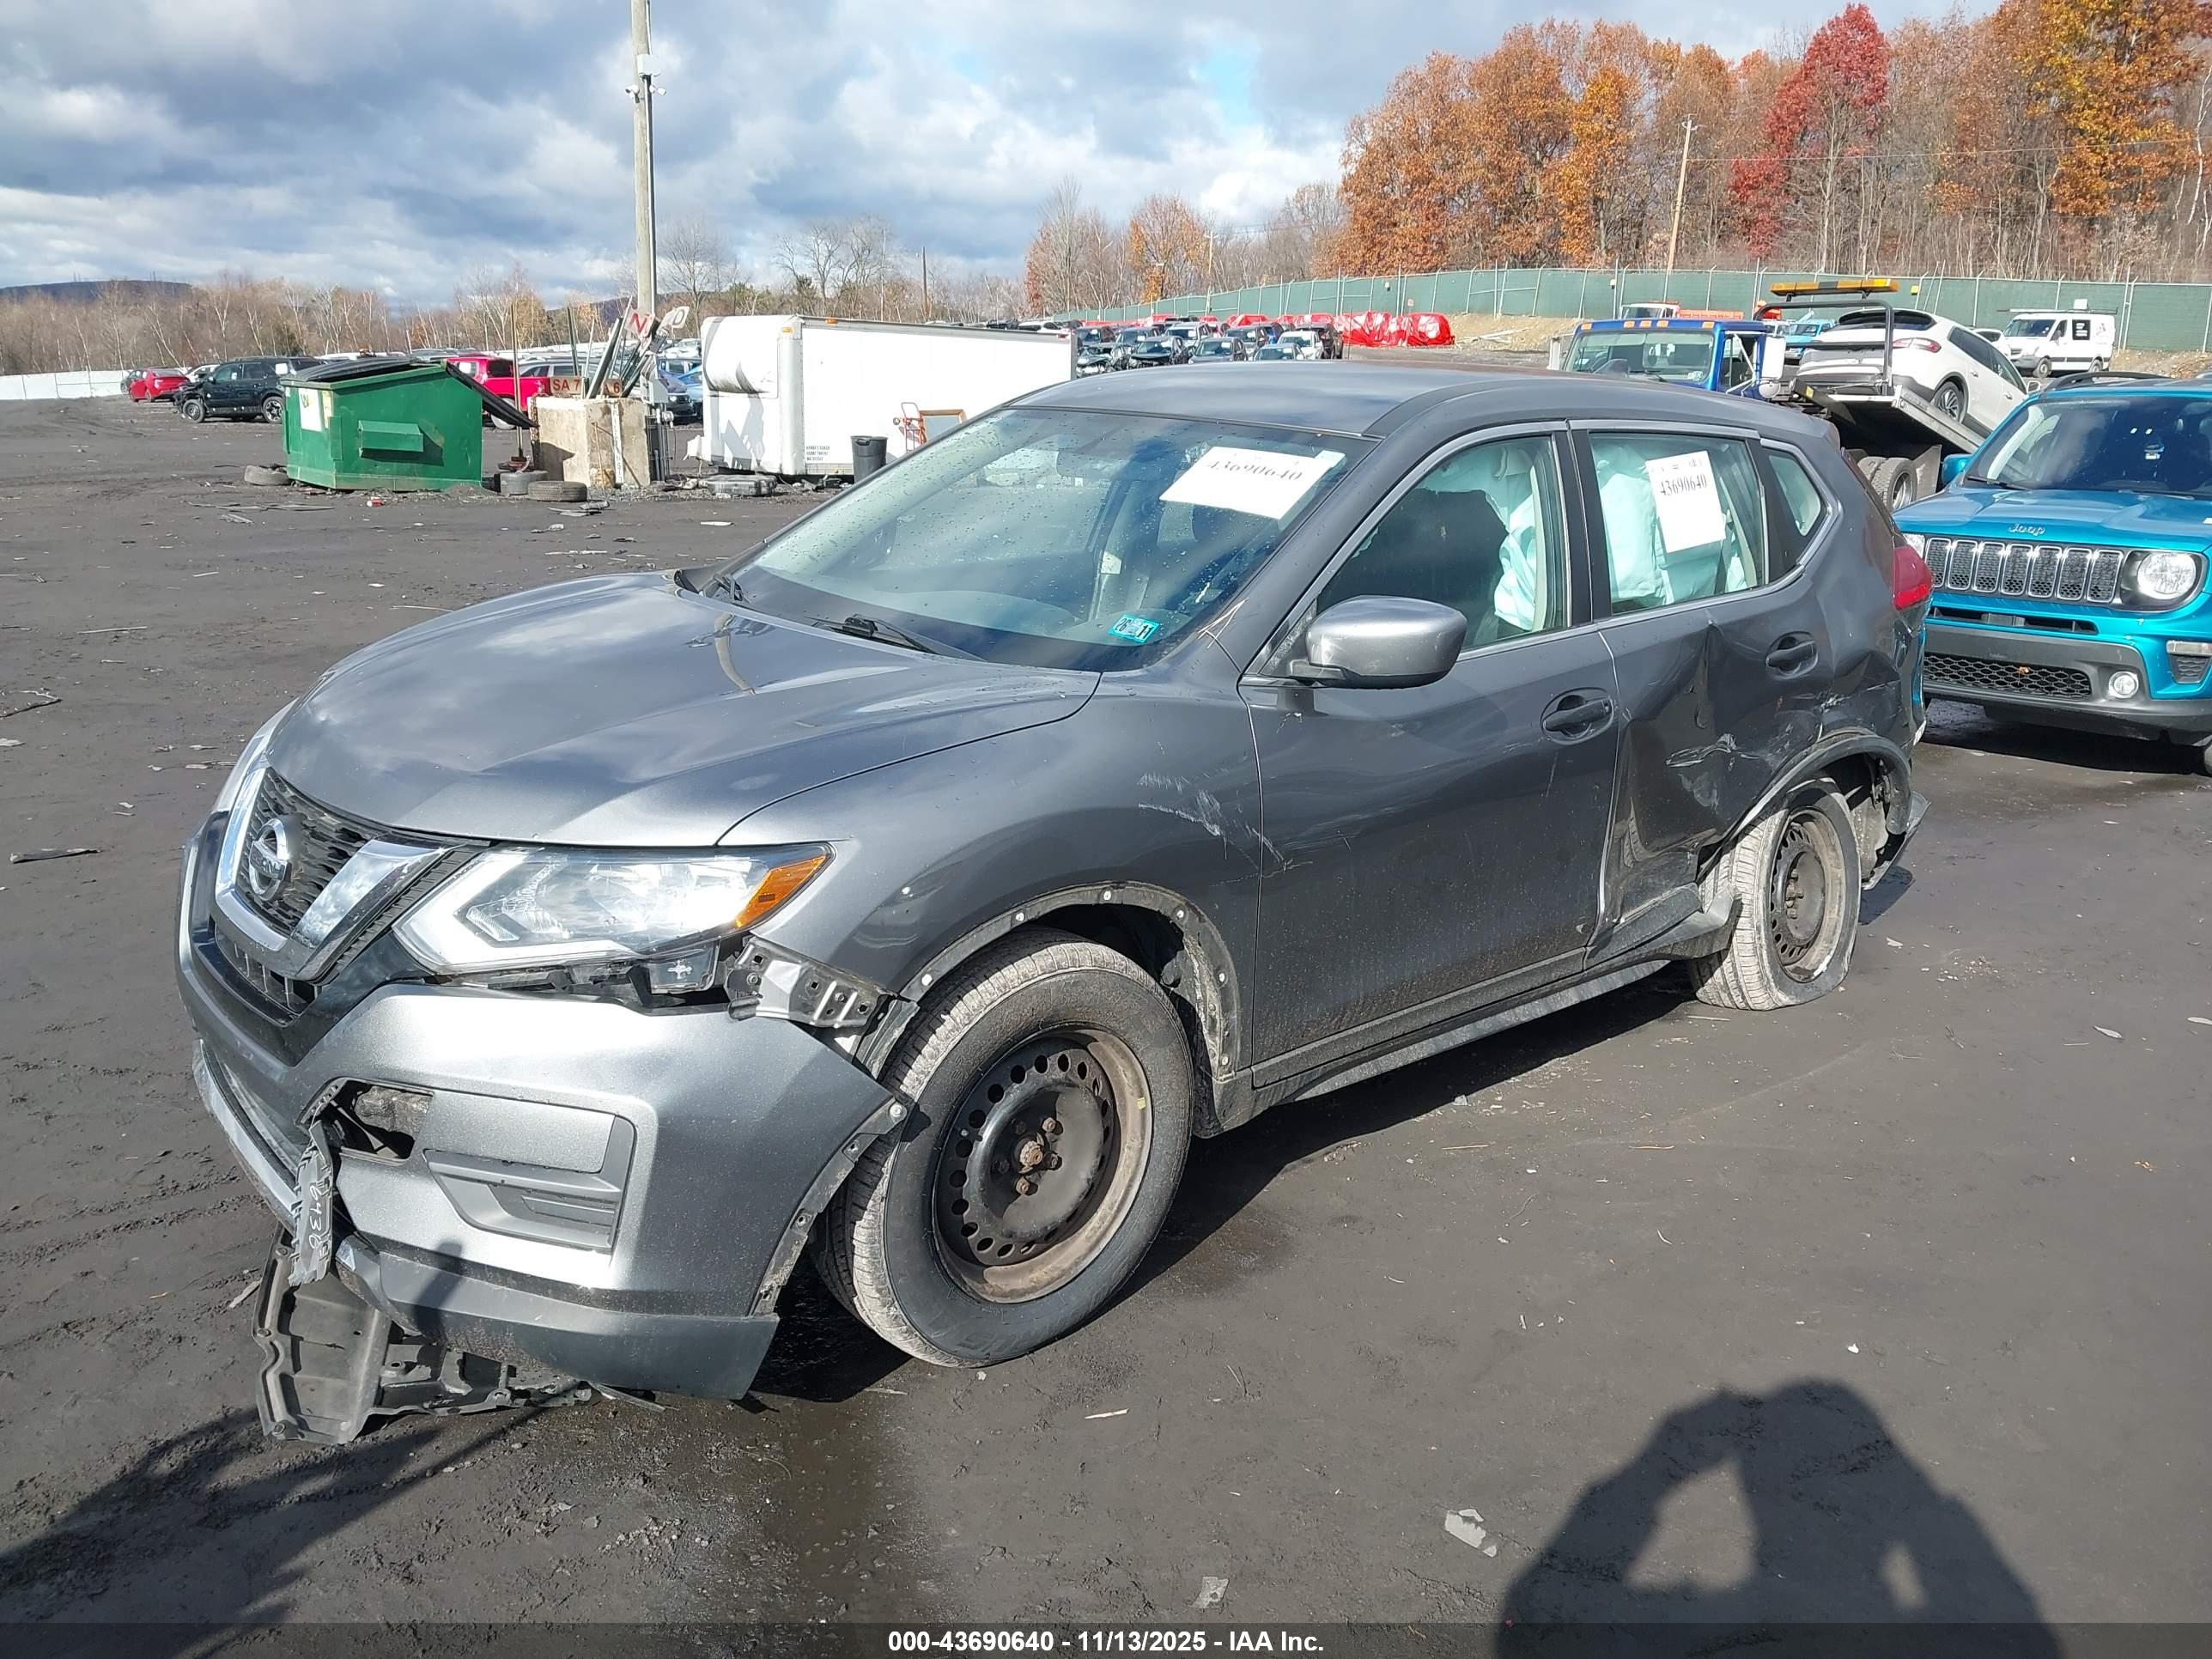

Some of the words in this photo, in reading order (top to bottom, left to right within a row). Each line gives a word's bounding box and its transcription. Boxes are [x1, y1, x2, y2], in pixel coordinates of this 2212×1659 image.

[552, 378, 571, 391] SA
[574, 378, 581, 391] 7
[1661, 473, 1707, 495] 43690640
[2008, 523, 2045, 537] Jeep
[1136, 624, 1155, 639] 11
